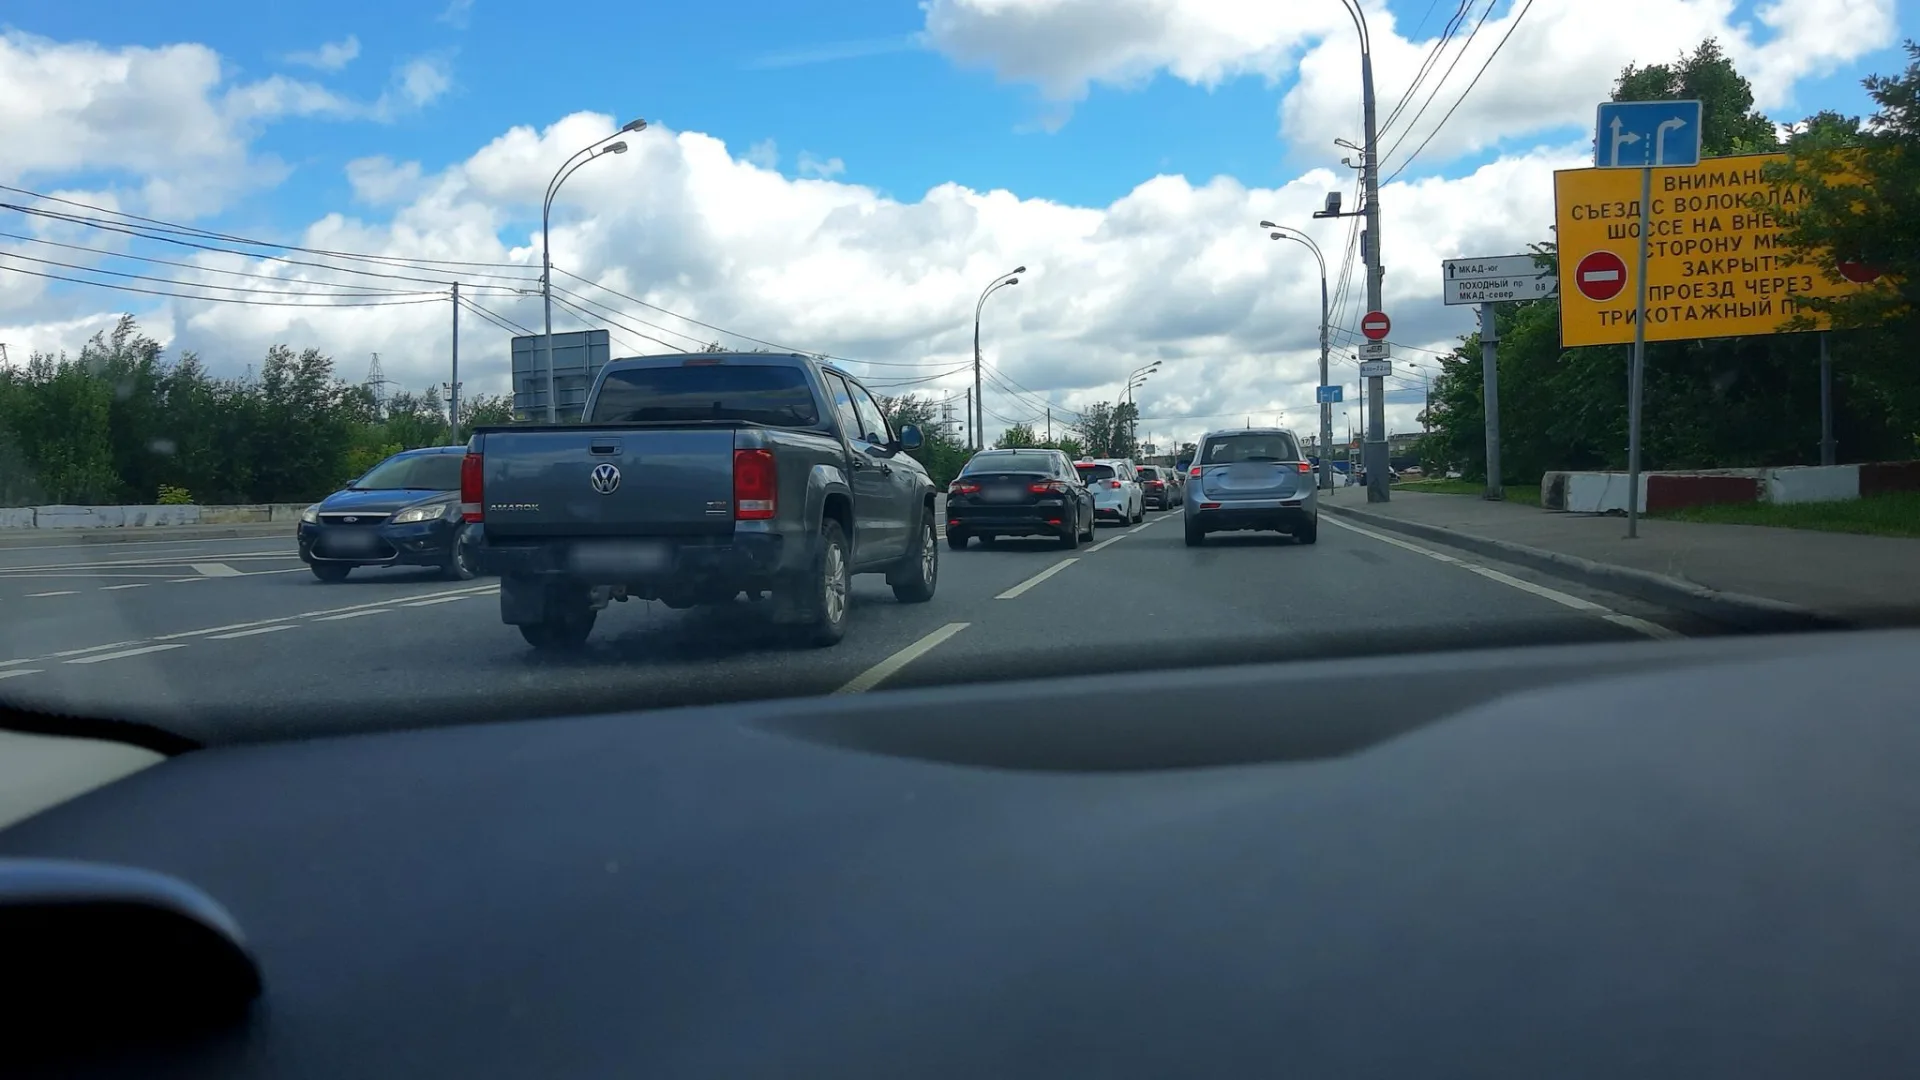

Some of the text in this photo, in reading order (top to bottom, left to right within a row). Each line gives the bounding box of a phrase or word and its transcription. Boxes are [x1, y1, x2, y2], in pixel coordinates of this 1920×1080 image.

[1664, 168, 1766, 192] ВНИМАН
[1571, 184, 1814, 222] СЪЕЗД С ВОЛОКОЛАМ
[1693, 215, 1723, 234] НА
[1459, 264, 1499, 274] МКАД-юг
[1681, 255, 1779, 278] ЗАКРЫТ!
[1459, 279, 1509, 291] ПОХОДНЫЙ
[1459, 290, 1514, 301] МКАД-север
[1649, 275, 1813, 302] ПРОЕЗД ЧЕРЕЗ
